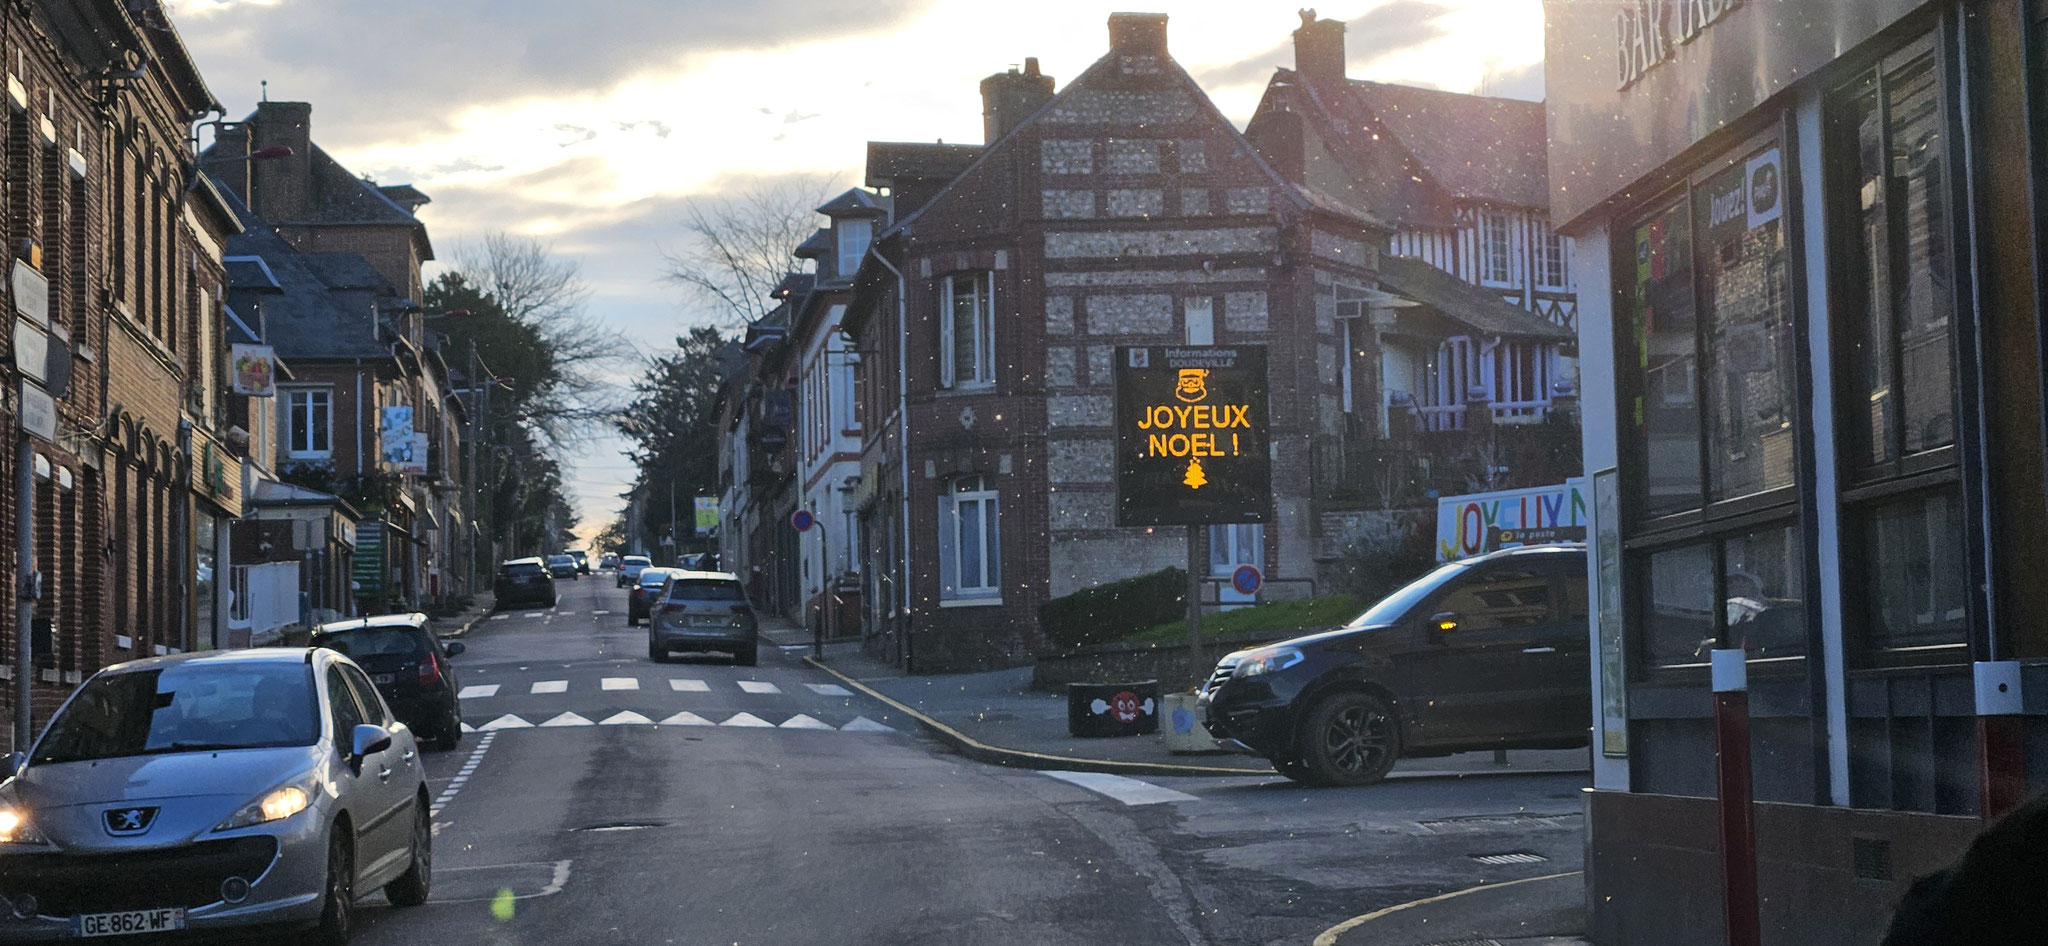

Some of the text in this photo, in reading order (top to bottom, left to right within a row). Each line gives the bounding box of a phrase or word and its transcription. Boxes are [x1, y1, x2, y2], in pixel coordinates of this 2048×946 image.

[1616, 0, 1666, 92] BAR
[1708, 177, 1745, 229] Jouez!
[1165, 348, 1237, 358] Informations
[1170, 358, 1233, 368] DOUDEVILLE
[1138, 405, 1250, 429] JOYEUX
[1149, 433, 1239, 456] NOEL !
[1441, 492, 1564, 557] JOYEUX
[1516, 530, 1556, 540] la poste
